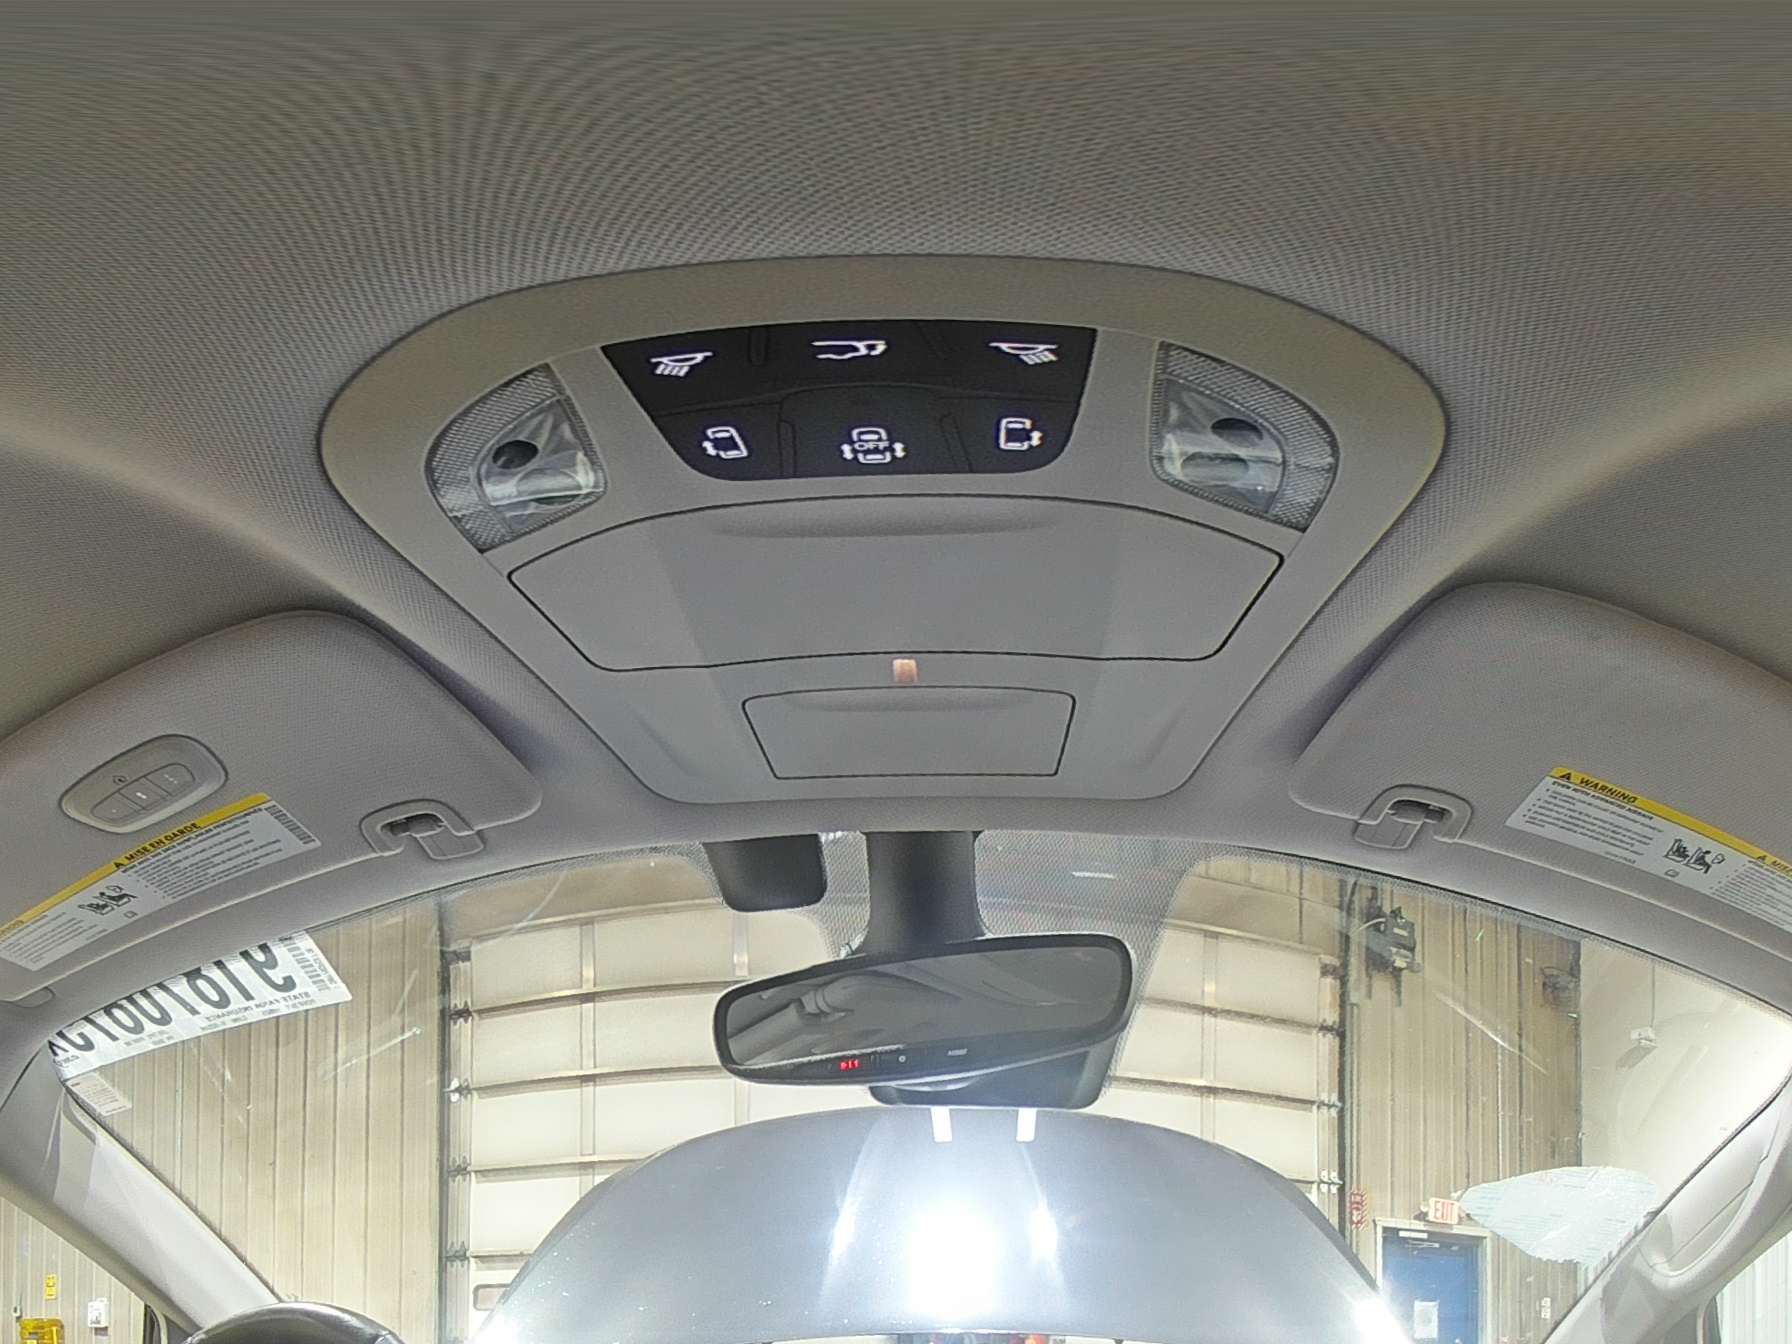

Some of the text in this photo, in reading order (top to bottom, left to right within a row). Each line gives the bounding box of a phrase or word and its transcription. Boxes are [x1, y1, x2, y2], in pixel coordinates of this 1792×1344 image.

[1579, 777, 1637, 804] WARNING
[124, 822, 201, 862] MISE EN GARDE
[1434, 1200, 1455, 1221] EXIT
